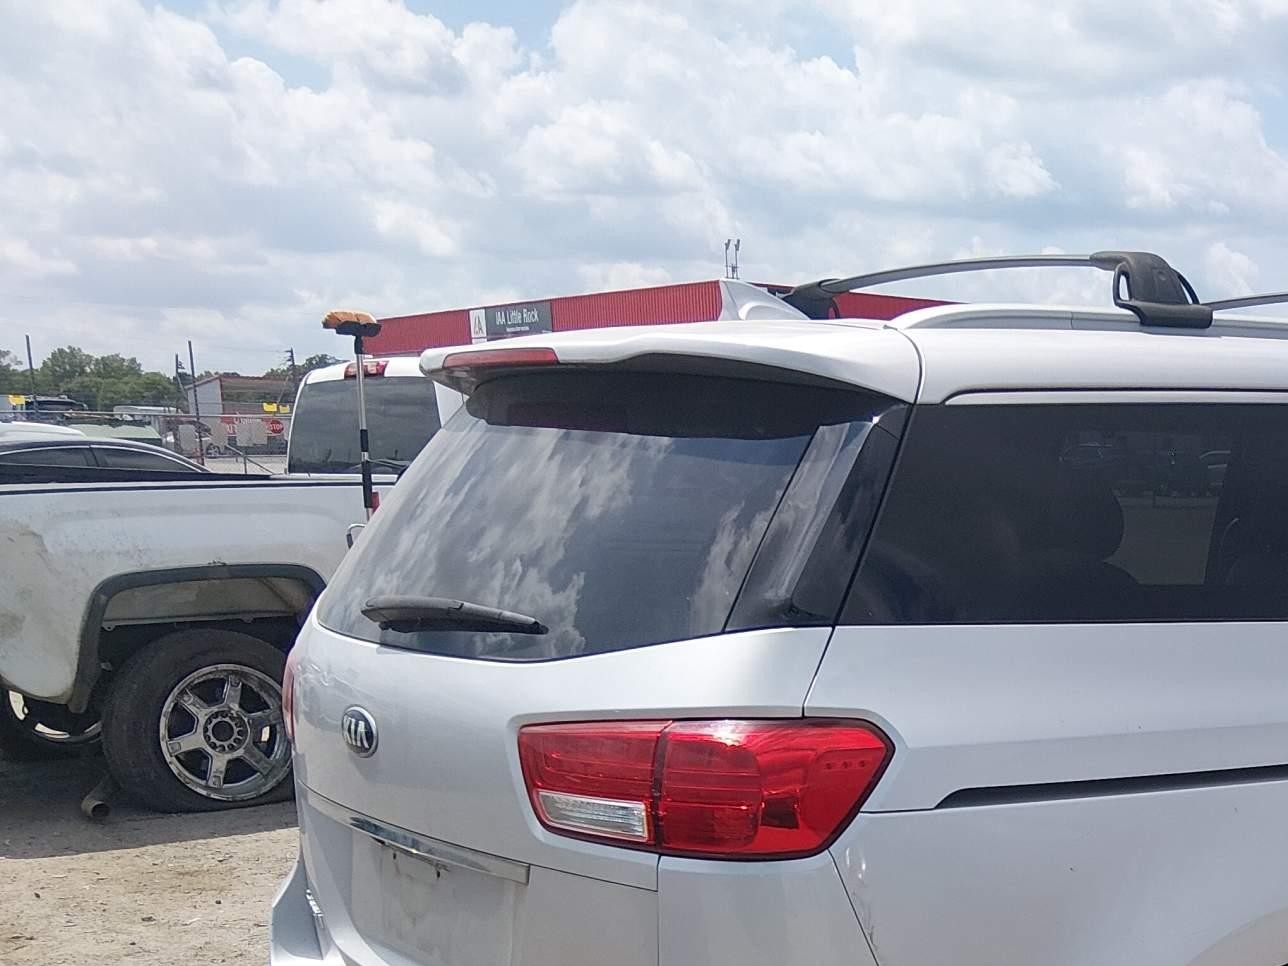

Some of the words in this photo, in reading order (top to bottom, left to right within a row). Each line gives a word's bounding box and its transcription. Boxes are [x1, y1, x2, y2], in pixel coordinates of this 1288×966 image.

[495, 311, 506, 325] IAA
[506, 308, 522, 325] Little
[523, 307, 539, 323] Rock
[343, 714, 370, 749] KIA
